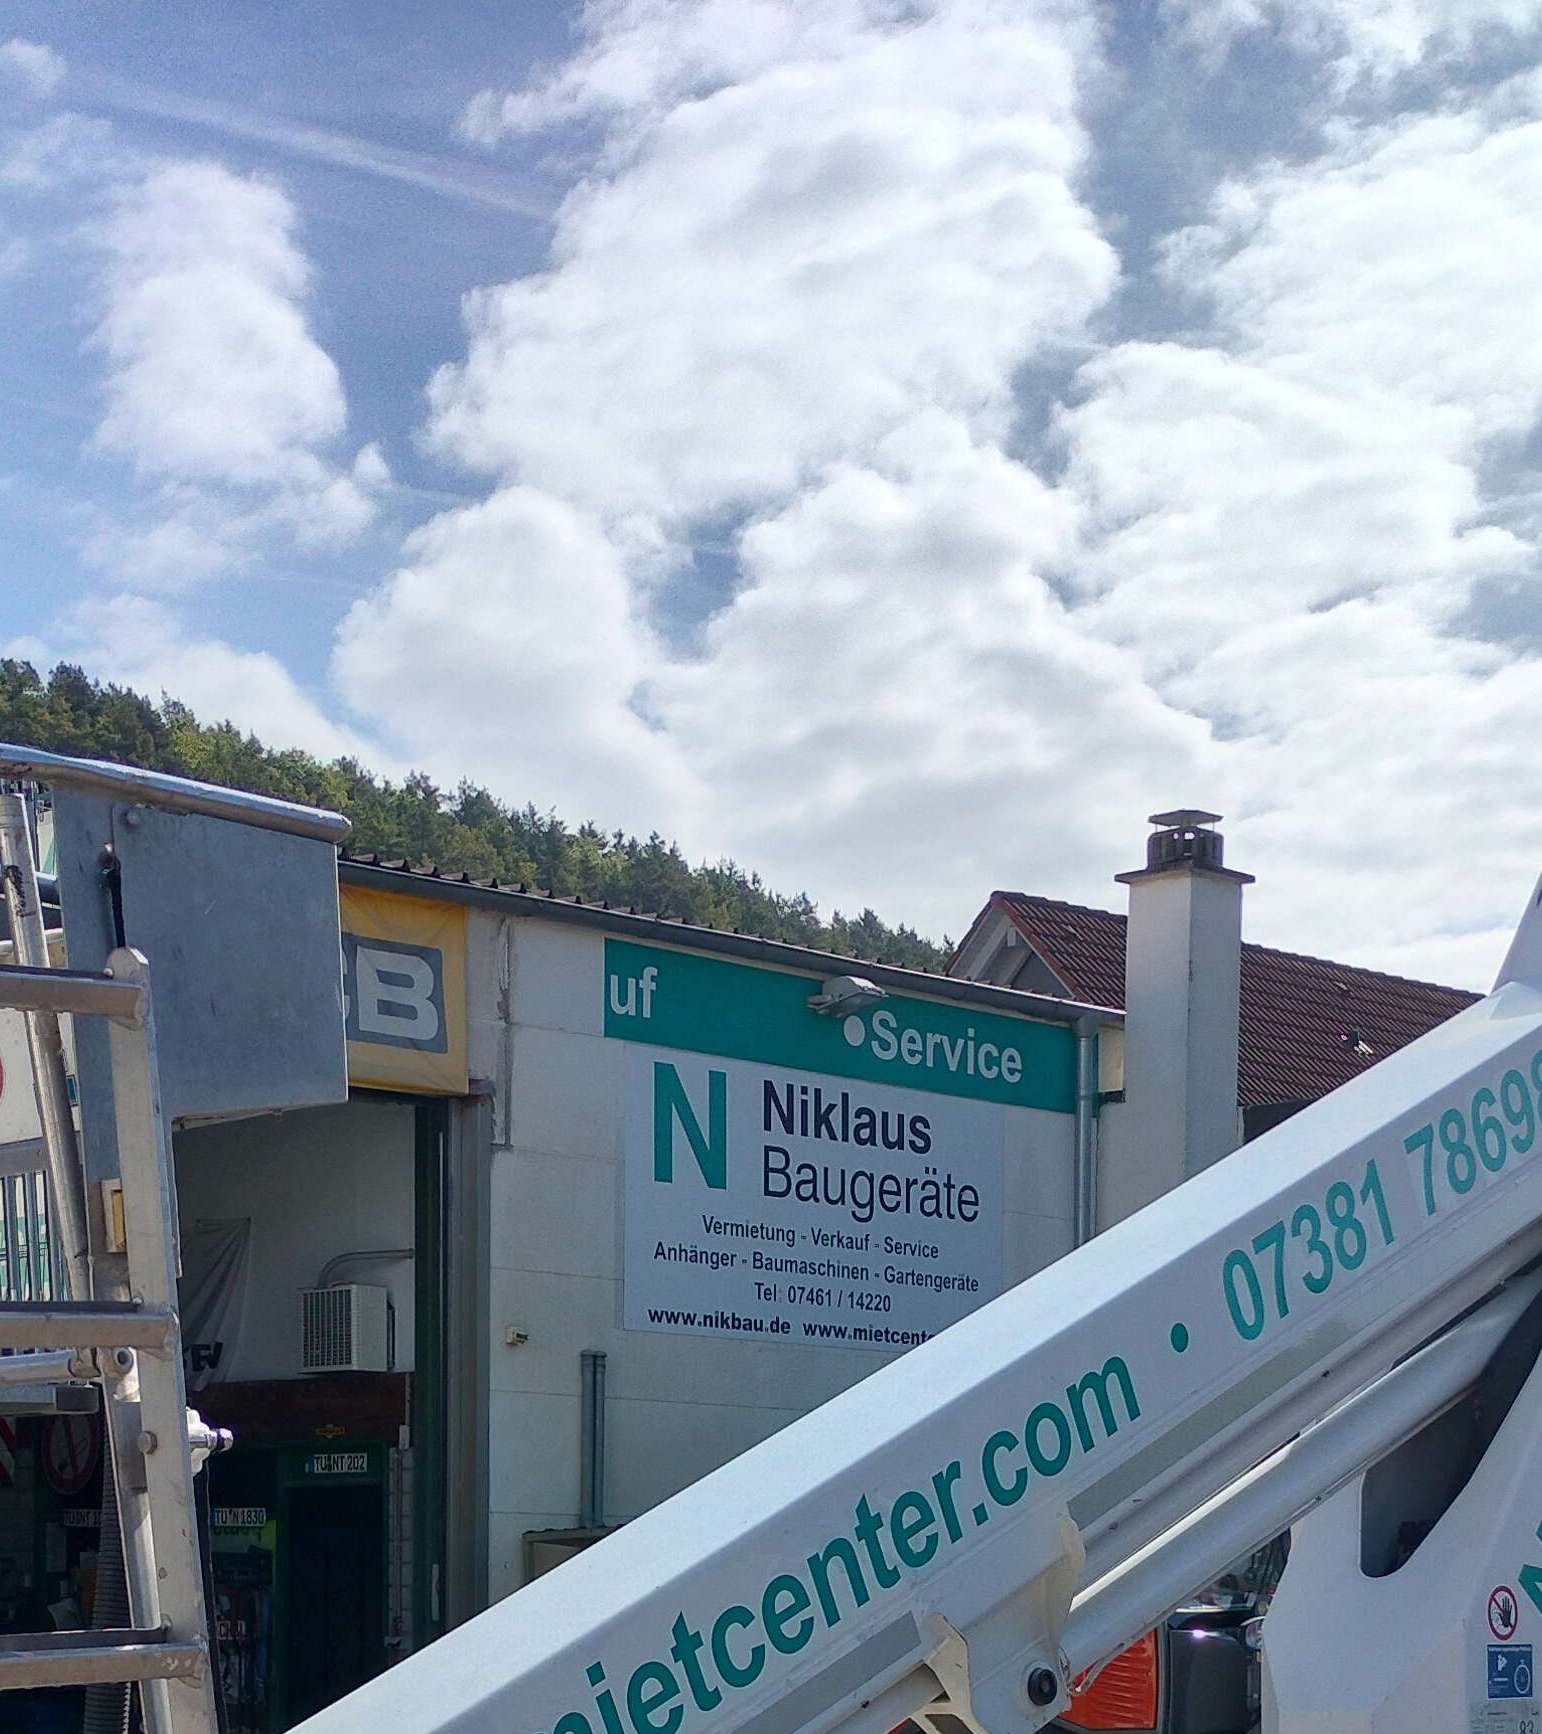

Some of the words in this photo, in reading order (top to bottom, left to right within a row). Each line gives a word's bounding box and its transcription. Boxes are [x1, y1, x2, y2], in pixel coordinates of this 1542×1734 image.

[342, 945, 439, 1041] B
[609, 966, 658, 1018] uf
[871, 1010, 1022, 1083] Service
[653, 1060, 727, 1190] N
[763, 1079, 931, 1154] Niklaus
[763, 1144, 980, 1223] Baugeräte
[702, 1214, 796, 1248] Vermietung
[810, 1226, 870, 1251] Verkauf
[884, 1235, 939, 1259] Service
[1222, 1159, 1394, 1341] 07381
[653, 1241, 737, 1270] Anhänger
[752, 1251, 869, 1281] Baumaschinen
[884, 1265, 979, 1293] Gartengeräte
[647, 1308, 791, 1335] www.nikbau.de
[788, 1285, 831, 1308] 07461
[837, 1290, 843, 1308] /
[848, 1290, 892, 1313] 14220
[315, 1455, 327, 1472] TU
[332, 1455, 345, 1471] NT
[347, 1454, 365, 1471] 202
[215, 1509, 227, 1525] TU
[240, 1509, 264, 1525] 1830
